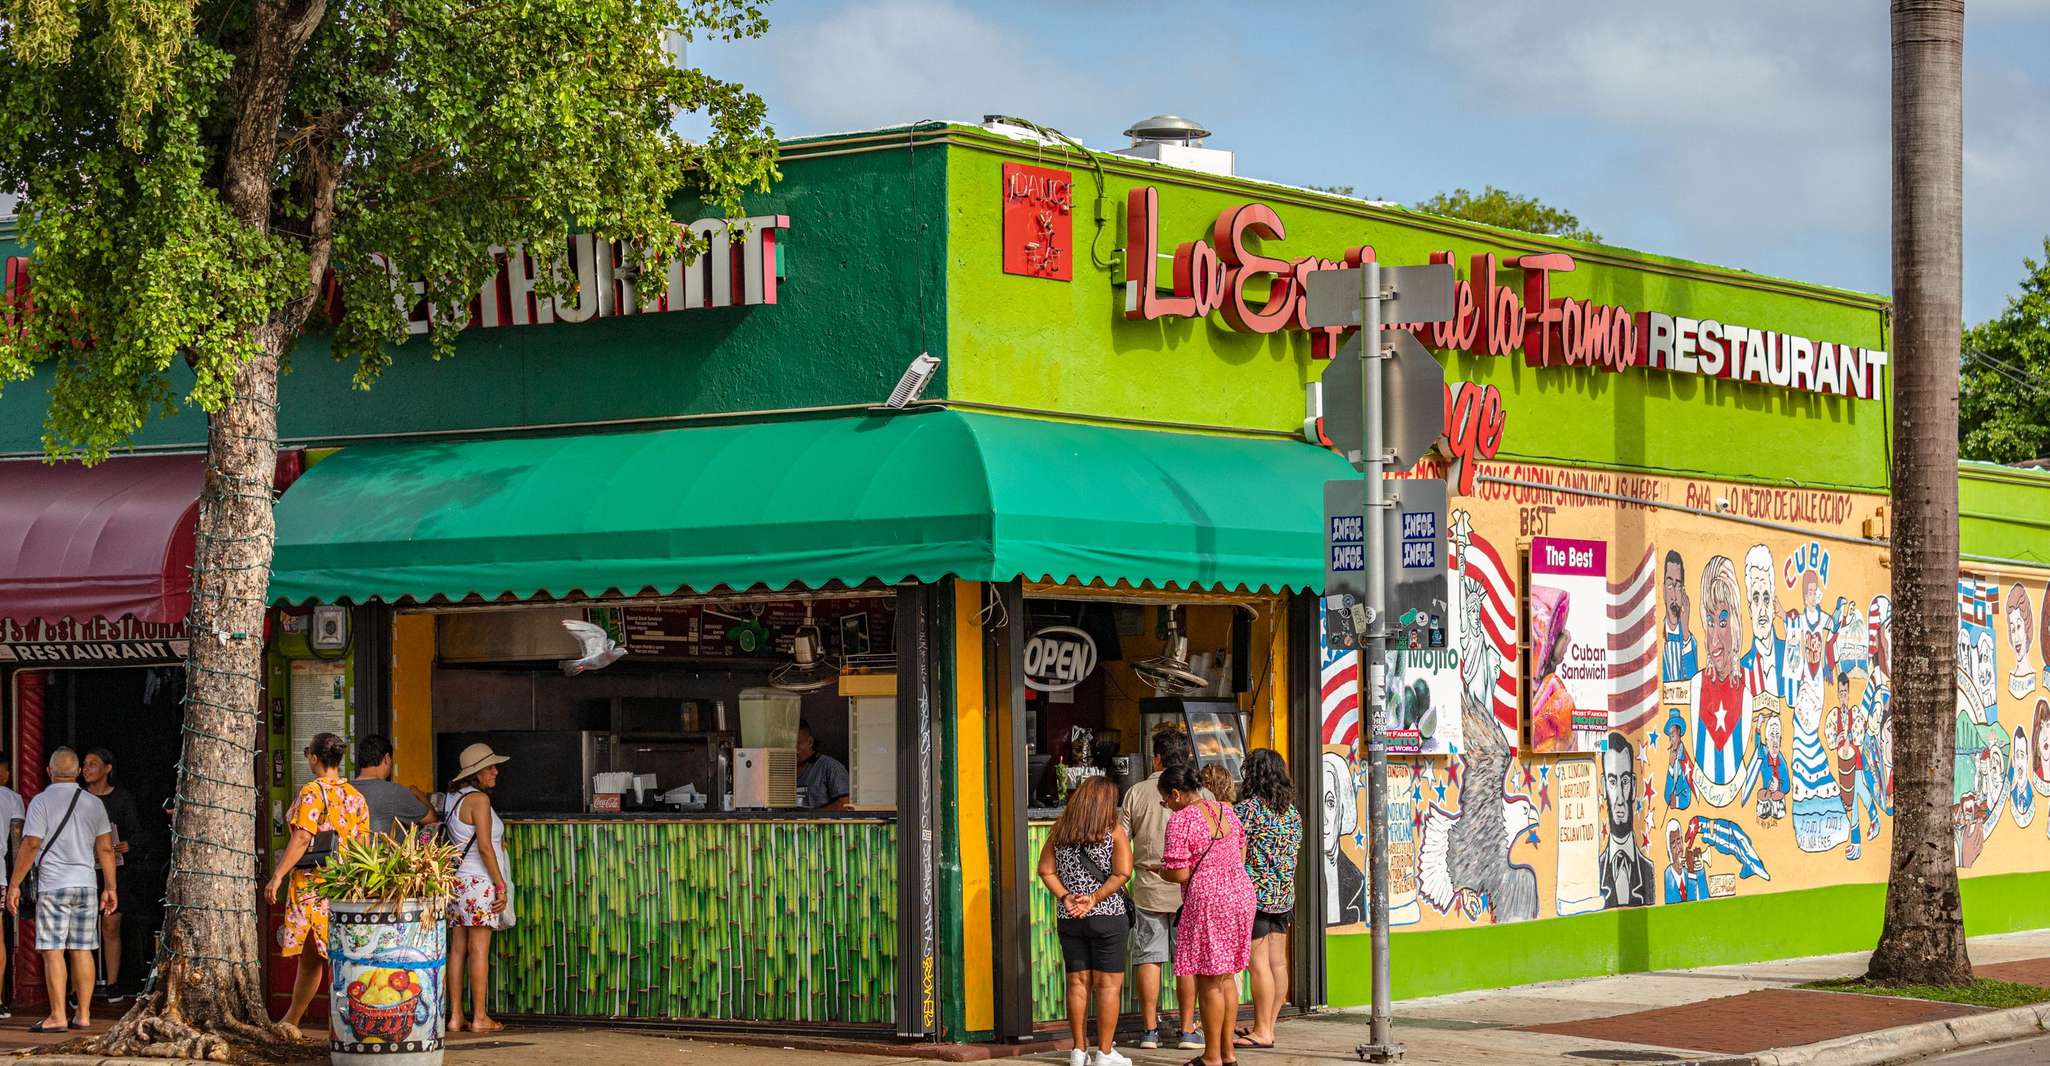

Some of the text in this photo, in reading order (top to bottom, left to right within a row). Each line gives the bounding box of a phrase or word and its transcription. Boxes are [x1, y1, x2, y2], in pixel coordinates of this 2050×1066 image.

[1128, 187, 1226, 320] La
[1484, 252, 1526, 356] la
[1519, 253, 1637, 374] Fama
[1650, 311, 1888, 401] RESTAURANT
[1616, 477, 1629, 511] IS
[1741, 488, 1772, 519] MEJOR
[1774, 490, 1788, 521] DE
[1789, 491, 1817, 524] CALLE
[1520, 506, 1556, 536] BEST
[1546, 546, 1593, 568] The Best
[1783, 541, 1831, 589] CUBA
[17, 643, 168, 661] RESTAURANT
[1024, 637, 1090, 681] OPEN
[1571, 644, 1606, 661] Cuban
[1561, 664, 1606, 681] Sandwich
